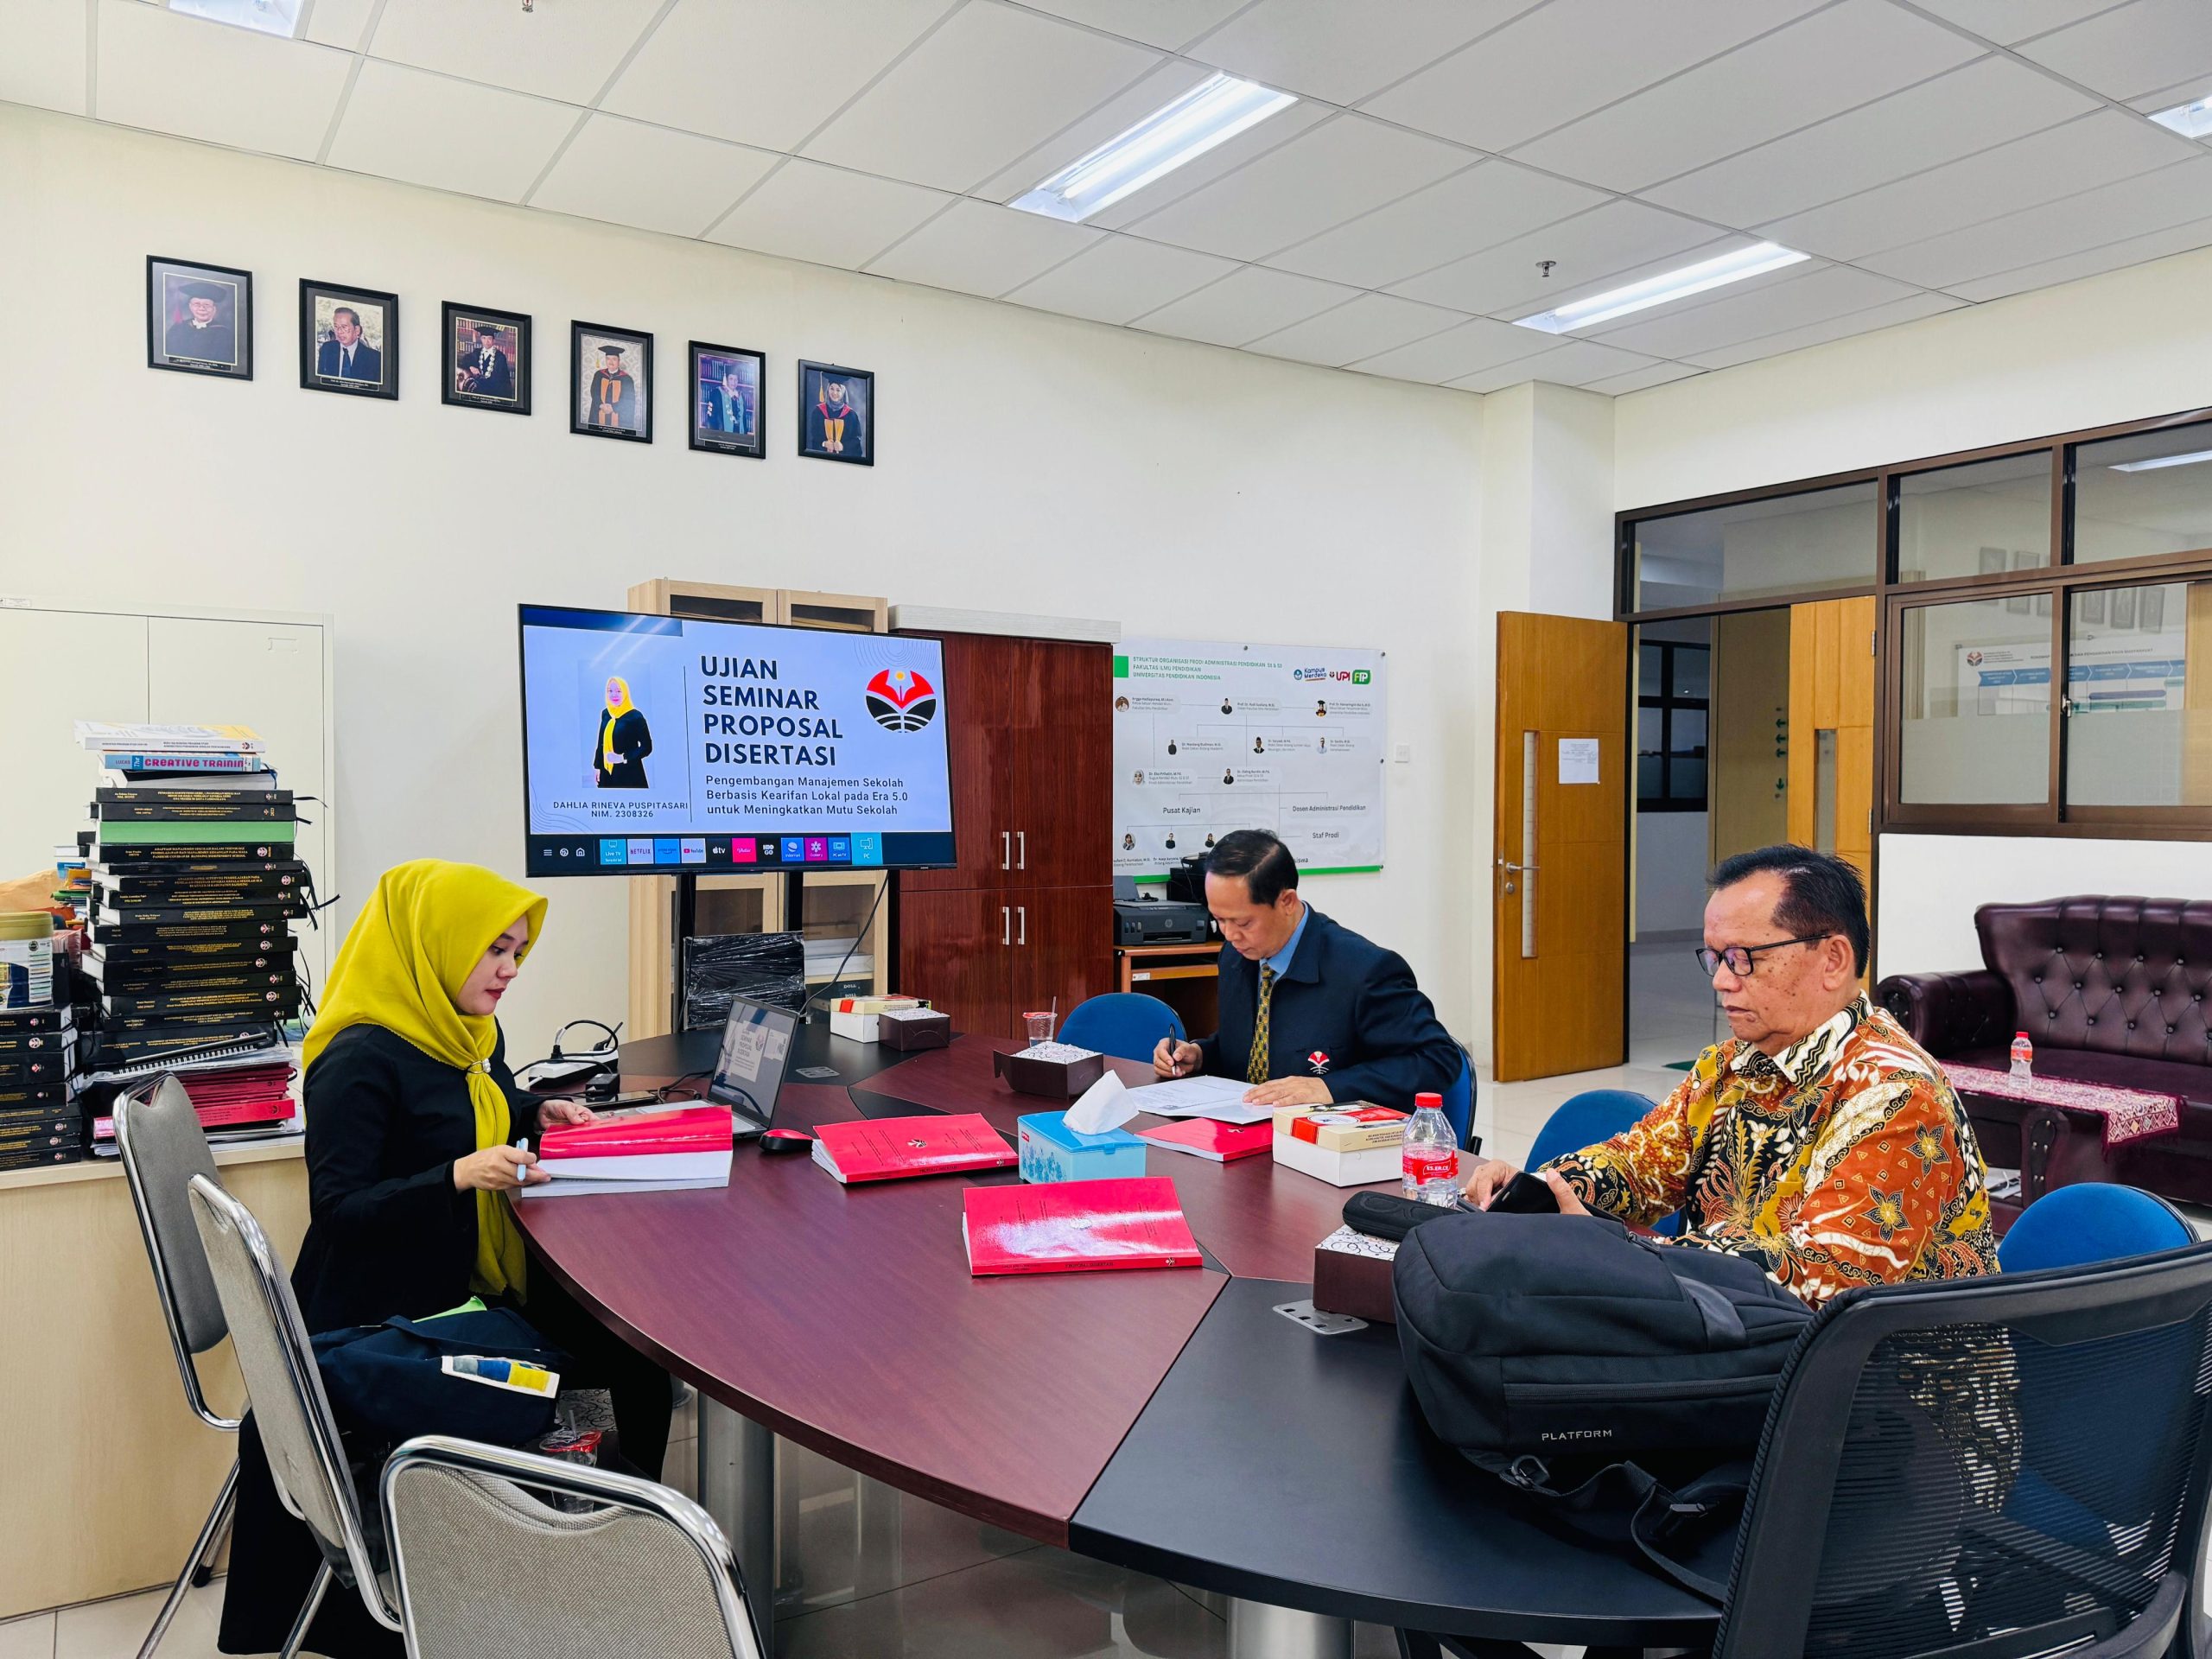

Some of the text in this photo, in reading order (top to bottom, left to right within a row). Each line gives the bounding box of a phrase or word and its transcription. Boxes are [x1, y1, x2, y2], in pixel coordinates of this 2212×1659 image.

[701, 655, 778, 680] UJIAN
[1336, 671, 1351, 681] UPI
[1354, 672, 1369, 683] FIP
[702, 684, 820, 710] SEMINAR
[703, 714, 843, 739] PROPOSAL
[705, 743, 836, 766] DISERTASI
[144, 758, 200, 767] CREATIVE
[202, 760, 244, 768] TRAININ
[705, 776, 904, 788] Pengembangan Manajemen Sekolah
[707, 790, 908, 803] Berbasis Kearifan Lokal pada Era 5.0
[707, 804, 897, 816] untuk Meningkatkan Mutu Sekolah
[1541, 1429, 1612, 1441] PLATFORM
